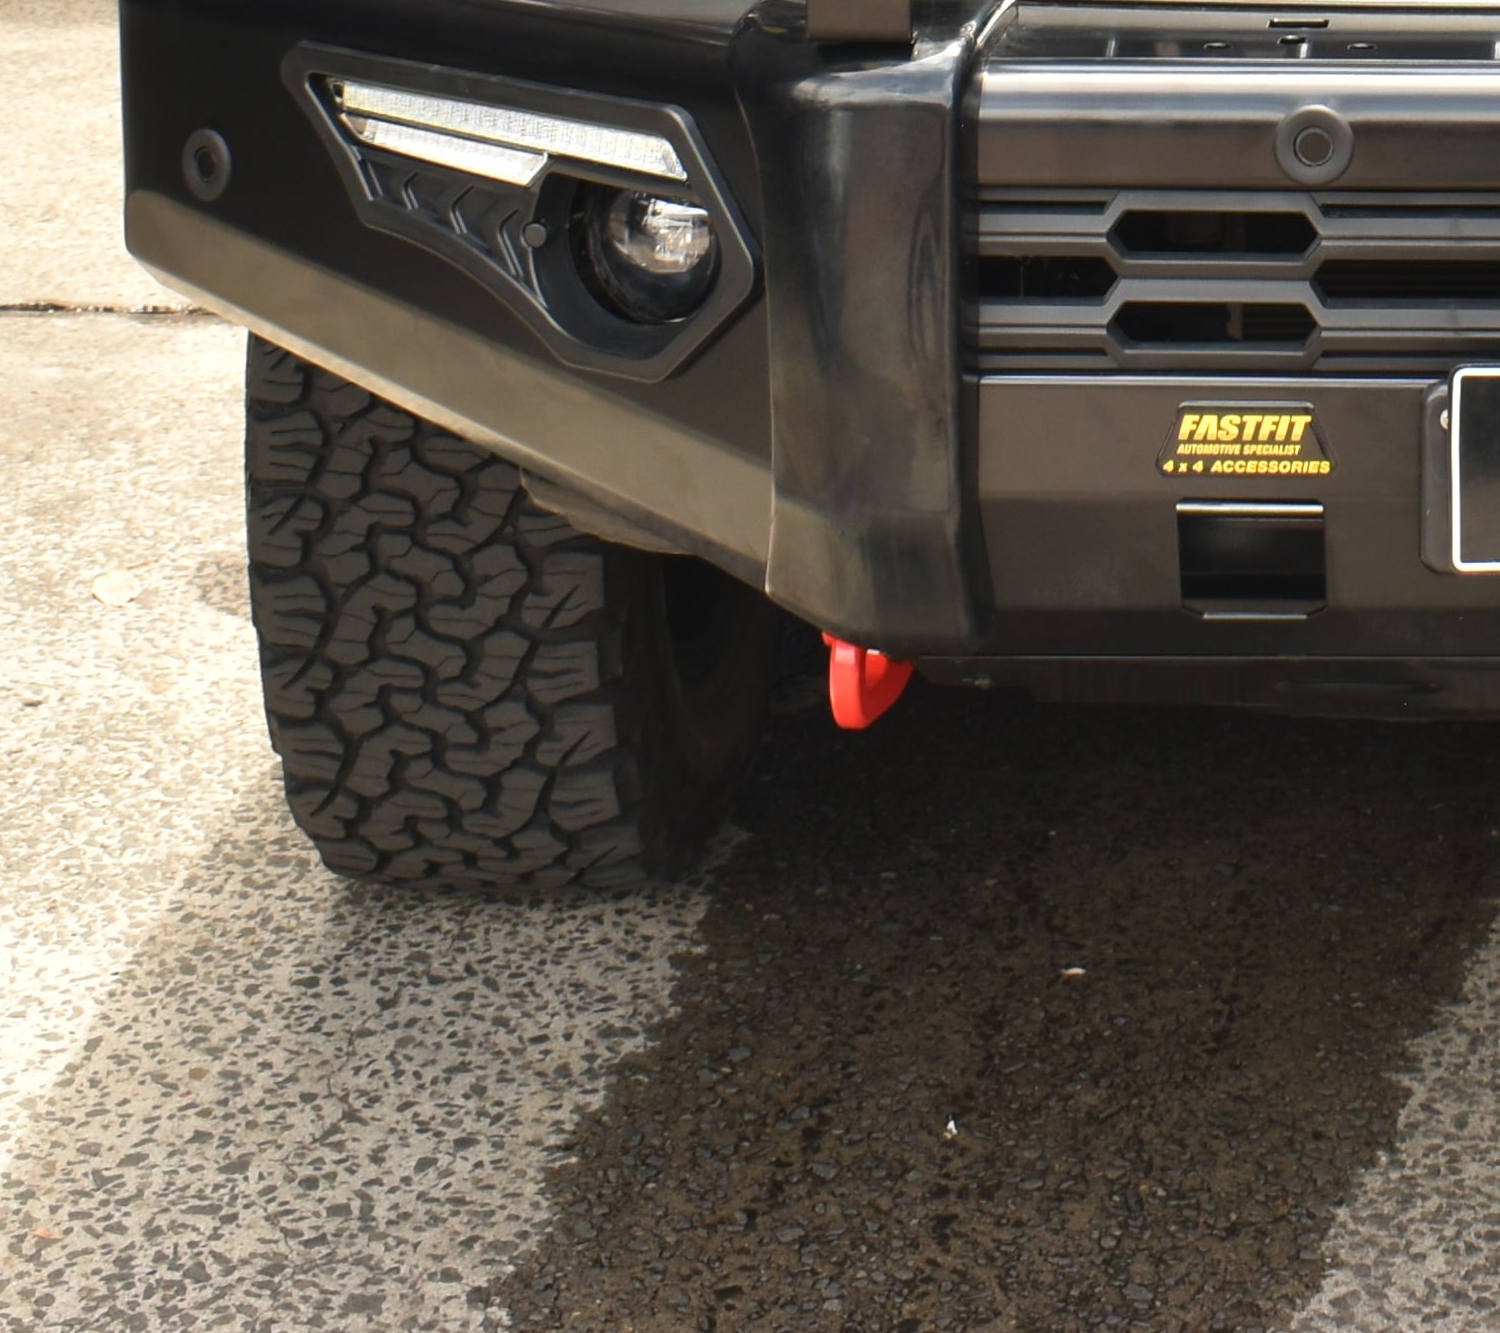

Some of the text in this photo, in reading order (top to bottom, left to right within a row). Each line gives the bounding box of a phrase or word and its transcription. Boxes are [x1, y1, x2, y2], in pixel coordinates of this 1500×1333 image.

[1178, 414, 1312, 442] FASTFIT
[1176, 443, 1302, 456] AUTOMOTIVE SPECIALIST
[1210, 460, 1331, 475] ACCESSORIES
